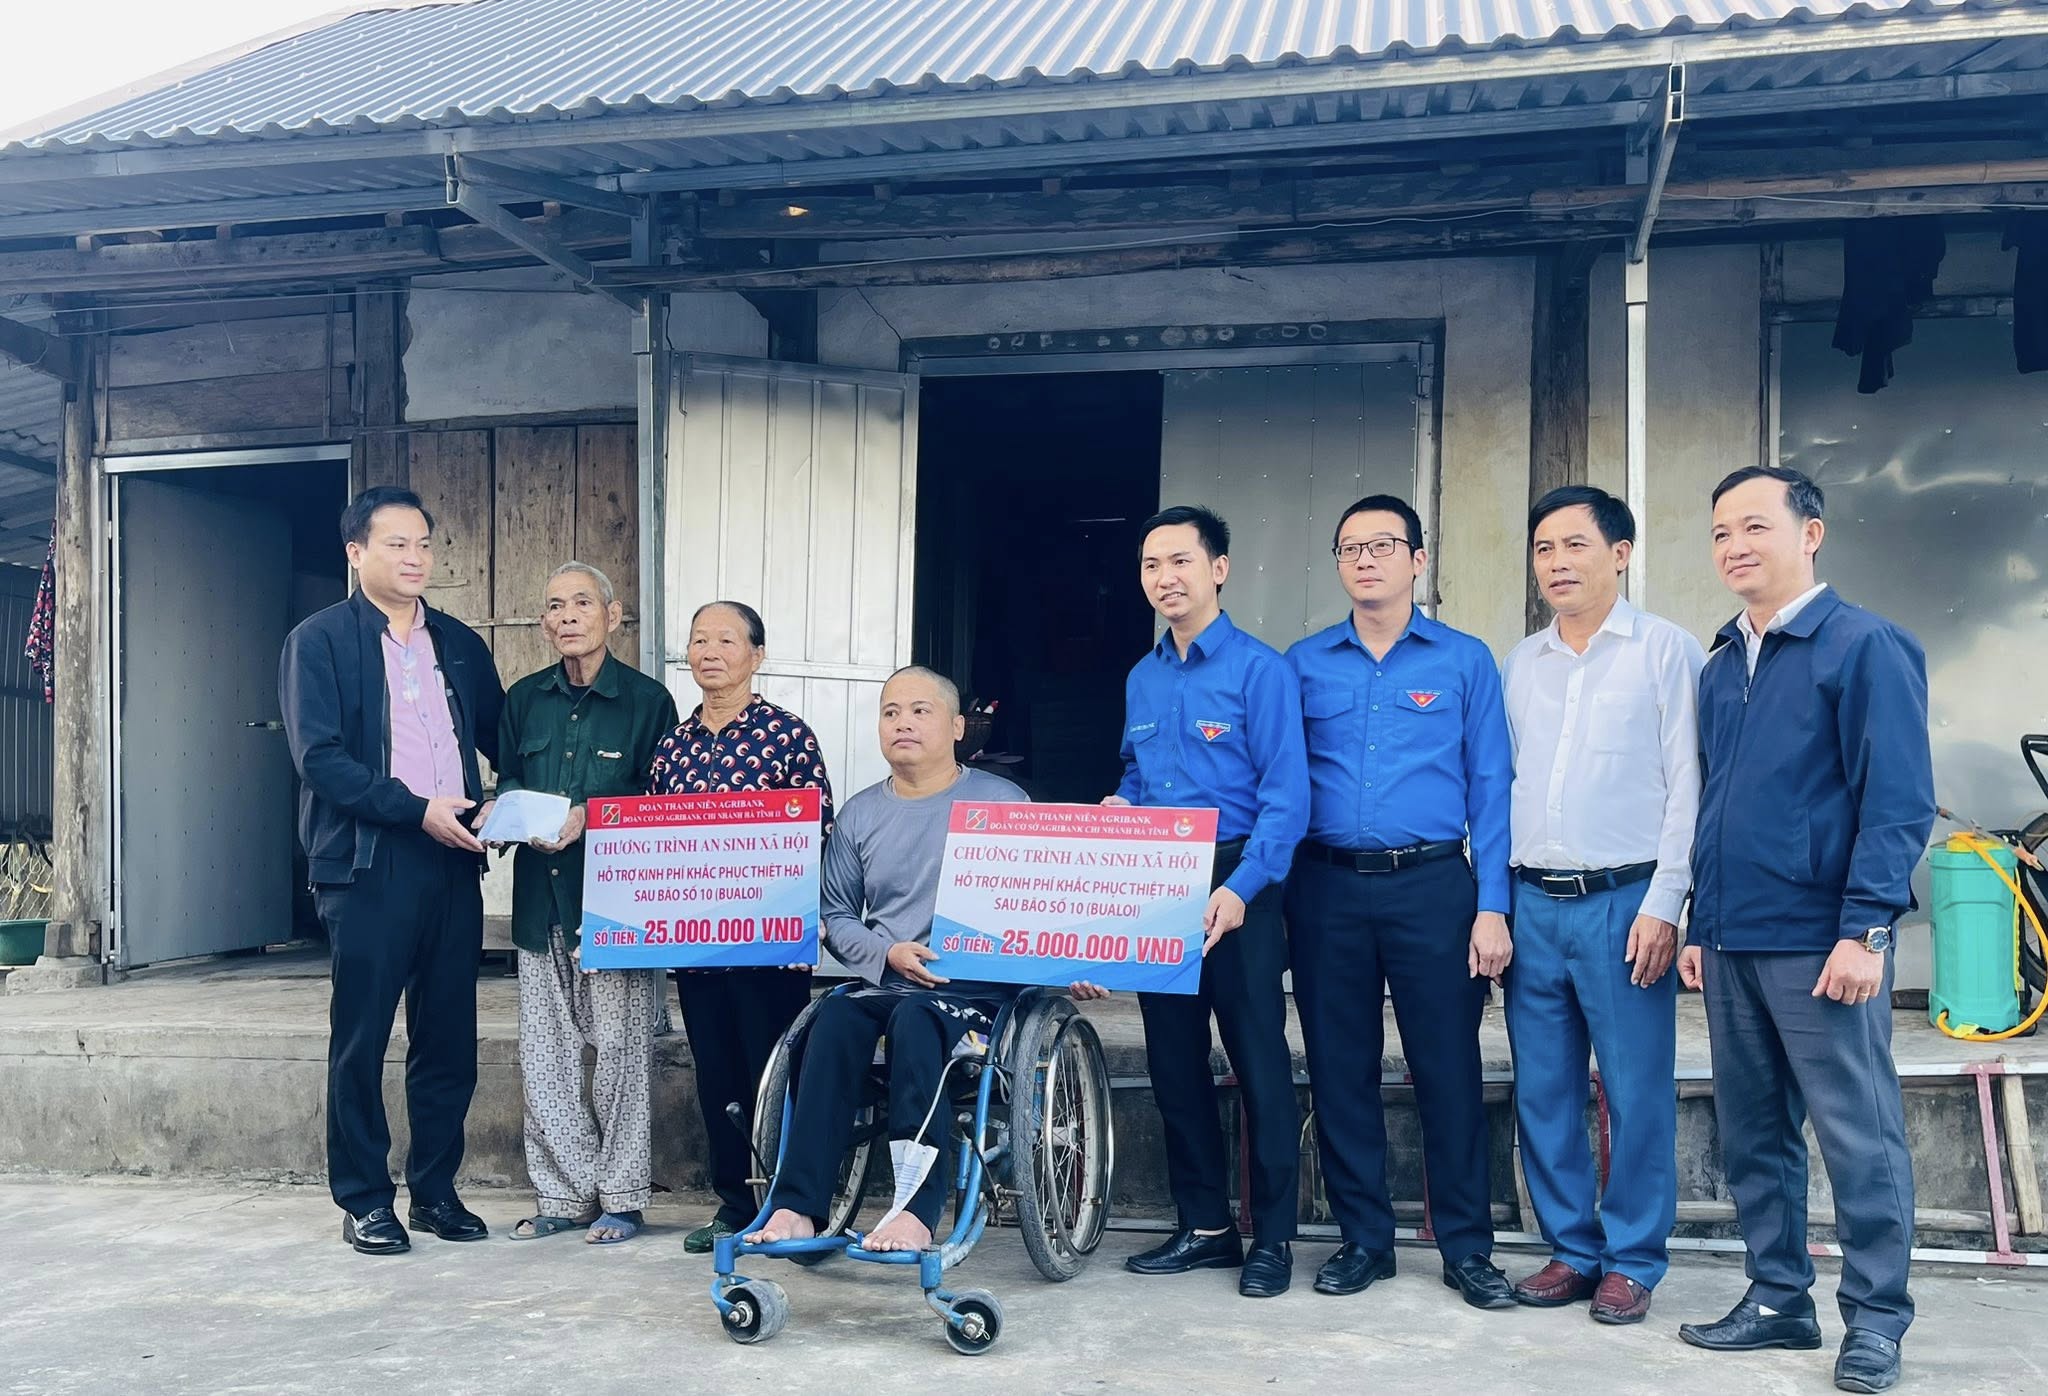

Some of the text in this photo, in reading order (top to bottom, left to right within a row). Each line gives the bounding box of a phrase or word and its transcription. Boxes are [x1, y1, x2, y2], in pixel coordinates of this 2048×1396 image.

[664, 801, 695, 811] THANH
[696, 799, 717, 810] NIÊN
[718, 799, 765, 809] AGRIBANK
[665, 813, 702, 822] AGRIBANK
[702, 812, 716, 820] CHI
[717, 810, 744, 820] NHÁNH
[744, 810, 755, 819] HÀ
[756, 809, 774, 818] TĨNH
[1008, 811, 1152, 825] ĐOÀN THANH NIÊN AGRIBANK
[1040, 824, 1085, 834] AGRIBANK
[1085, 825, 1100, 834] CHI
[1102, 826, 1132, 835] NHÁNH
[1133, 827, 1145, 836] HÀ
[1148, 827, 1169, 836] TĨNH
[594, 832, 809, 856] CHƯƠNG TRÌNH AN SINH XÃ HỘI
[953, 846, 1199, 872] CHƯƠNG TRÌNH AN SINH XÃ HỘI
[597, 862, 804, 885] HỖ TRỢ KINH PHÍ KHẮC PHỤC THIỆT HẠI
[954, 870, 1190, 900] HỖ TRỢ KINH PHÍ KHẮC PHỤC THIỆT HẠI
[634, 885, 763, 902] SAU BÃO SỐ 10 (BUALOI)
[994, 896, 1141, 919] SAU BÃO SỐ 10 (BUALOI)
[594, 916, 804, 945] SỐ TIỀN: 25.000.000 VND
[943, 929, 1184, 964] SỐ TIỀN: 25.000.000 VND
